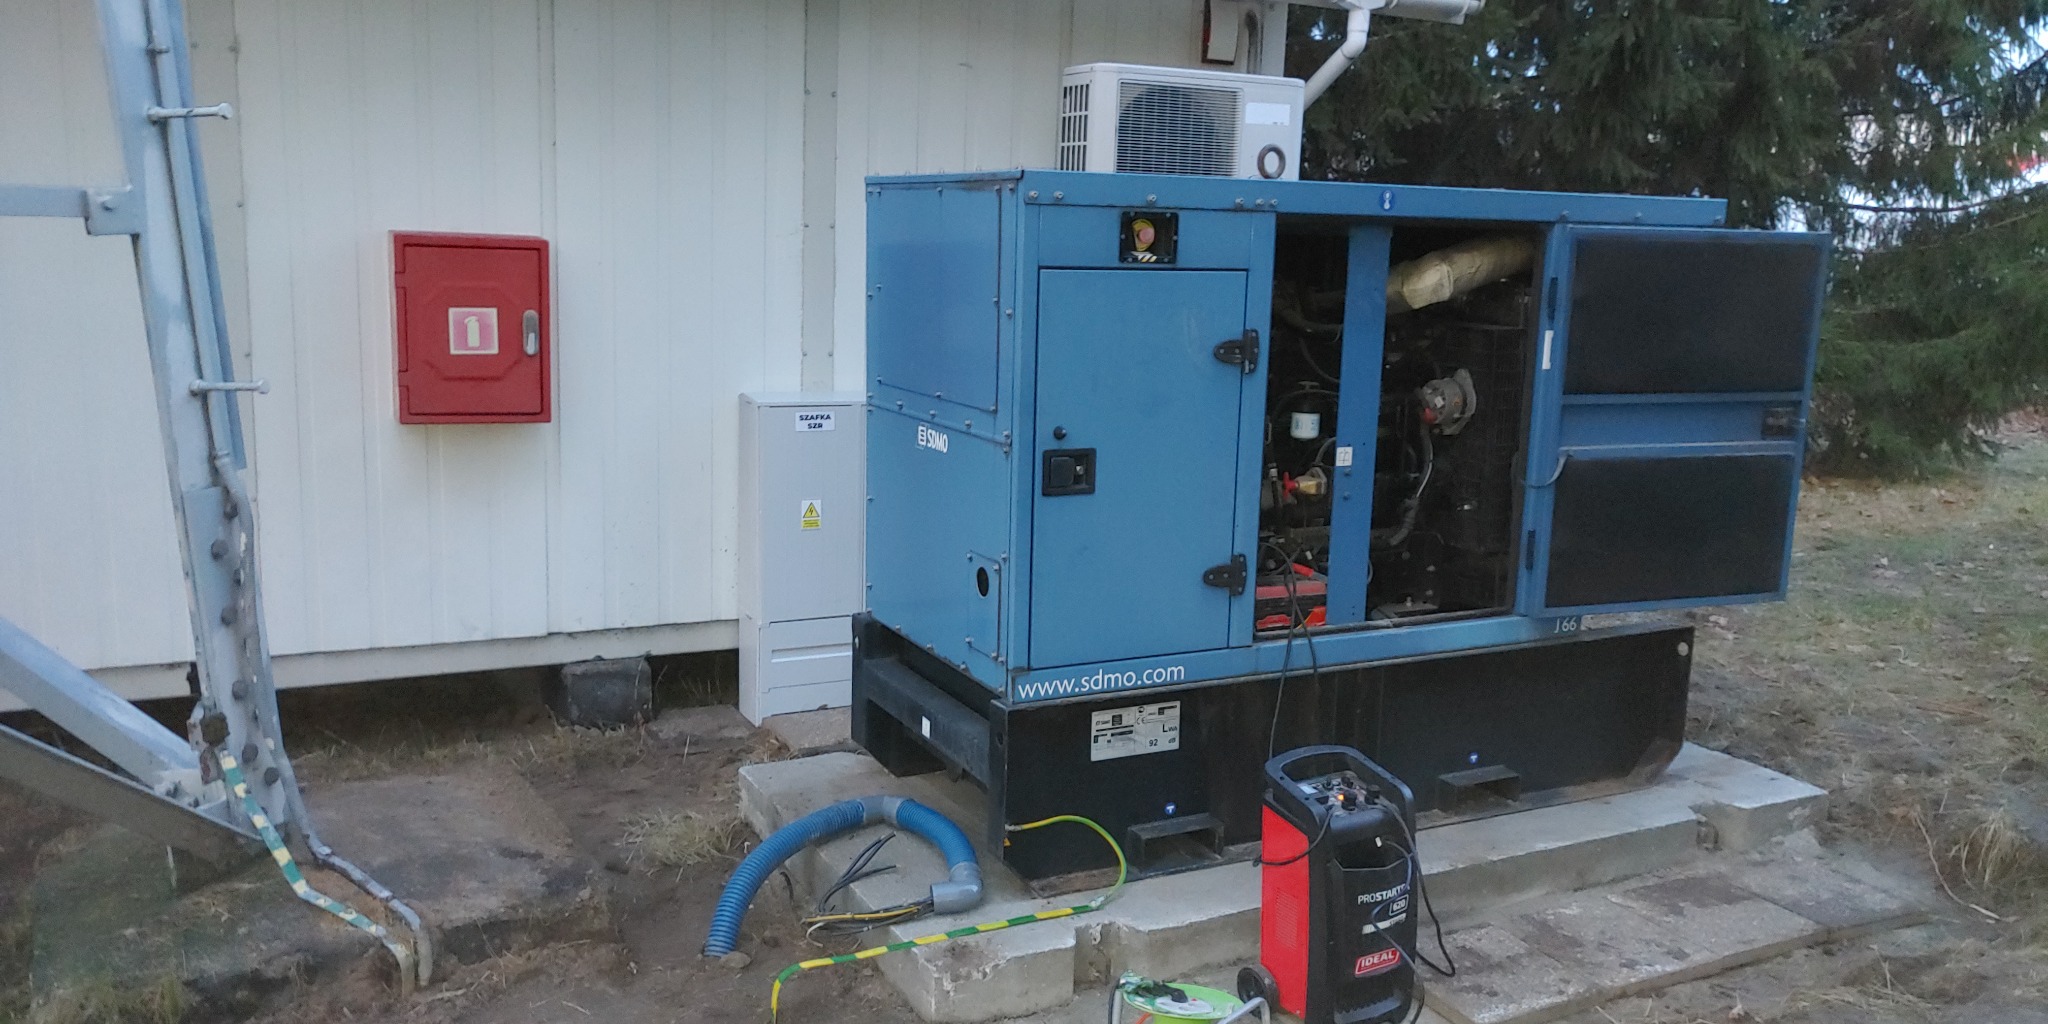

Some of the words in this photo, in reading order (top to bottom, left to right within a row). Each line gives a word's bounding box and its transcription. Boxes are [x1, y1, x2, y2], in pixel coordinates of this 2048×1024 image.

[807, 422, 823, 430] SZR
[927, 429, 948, 453] SDMO
[1018, 665, 1185, 699] www.sdmo.com
[1148, 738, 1159, 747] 92
[1357, 883, 1410, 905] PROSTART
[1392, 899, 1406, 911] 620
[1361, 951, 1395, 967] IDEAL
